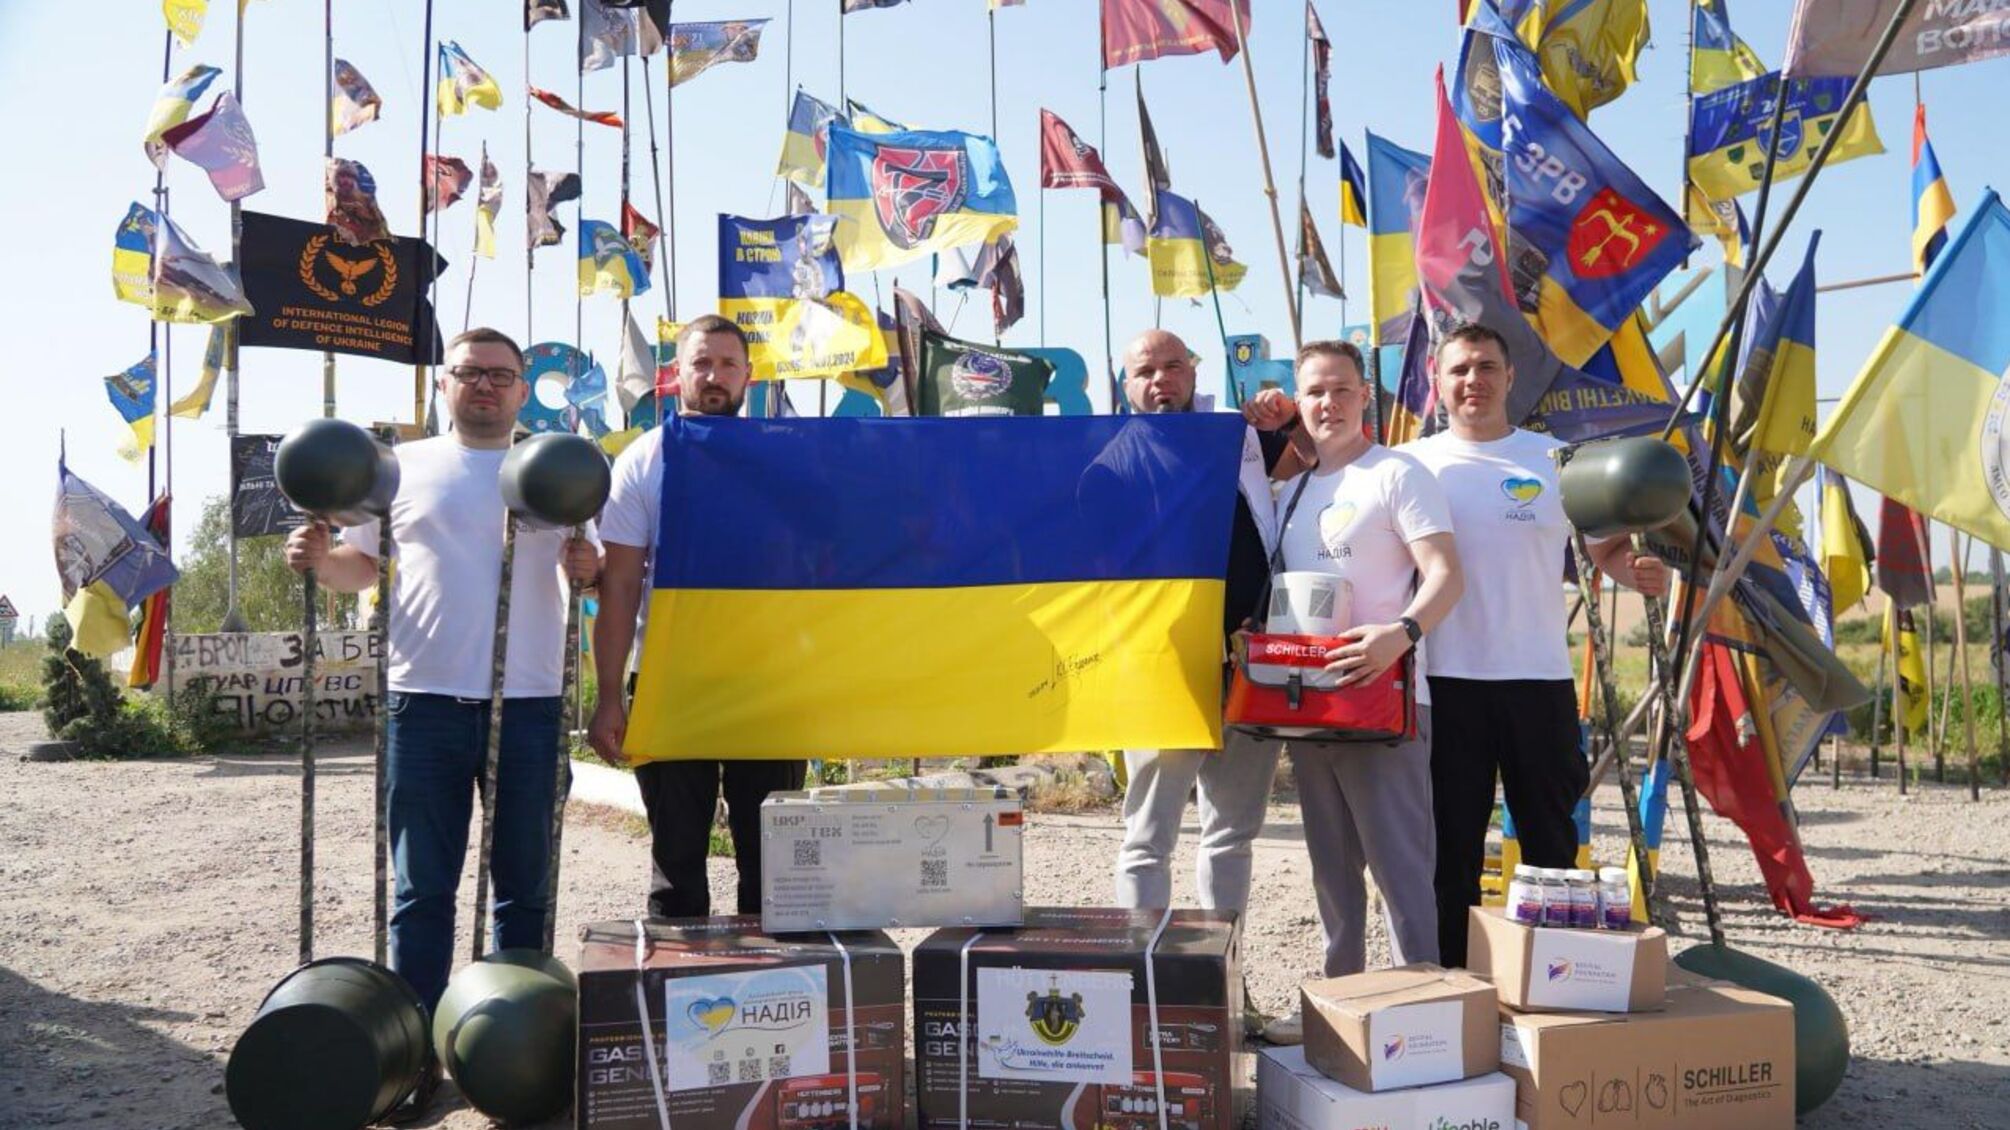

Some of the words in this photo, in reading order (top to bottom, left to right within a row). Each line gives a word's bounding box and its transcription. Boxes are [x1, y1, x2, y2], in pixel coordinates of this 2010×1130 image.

[272, 318, 290, 329] OF
[291, 319, 343, 333] DEFENCE
[282, 306, 372, 325] INTERNATIONAL
[374, 317, 410, 332] LEGION
[315, 334, 332, 345] OF
[334, 336, 382, 351] UKRAINE
[1317, 546, 1352, 561] НАДІЯ
[1265, 642, 1327, 658] SCHILLER
[742, 1000, 812, 1024] НАДІЯ
[1684, 1062, 1773, 1090] SCHILLER
[1684, 1096, 1699, 1107] The
[1701, 1094, 1714, 1105] Art
[1715, 1093, 1725, 1104] of
[1726, 1091, 1772, 1104] Diagnostics
